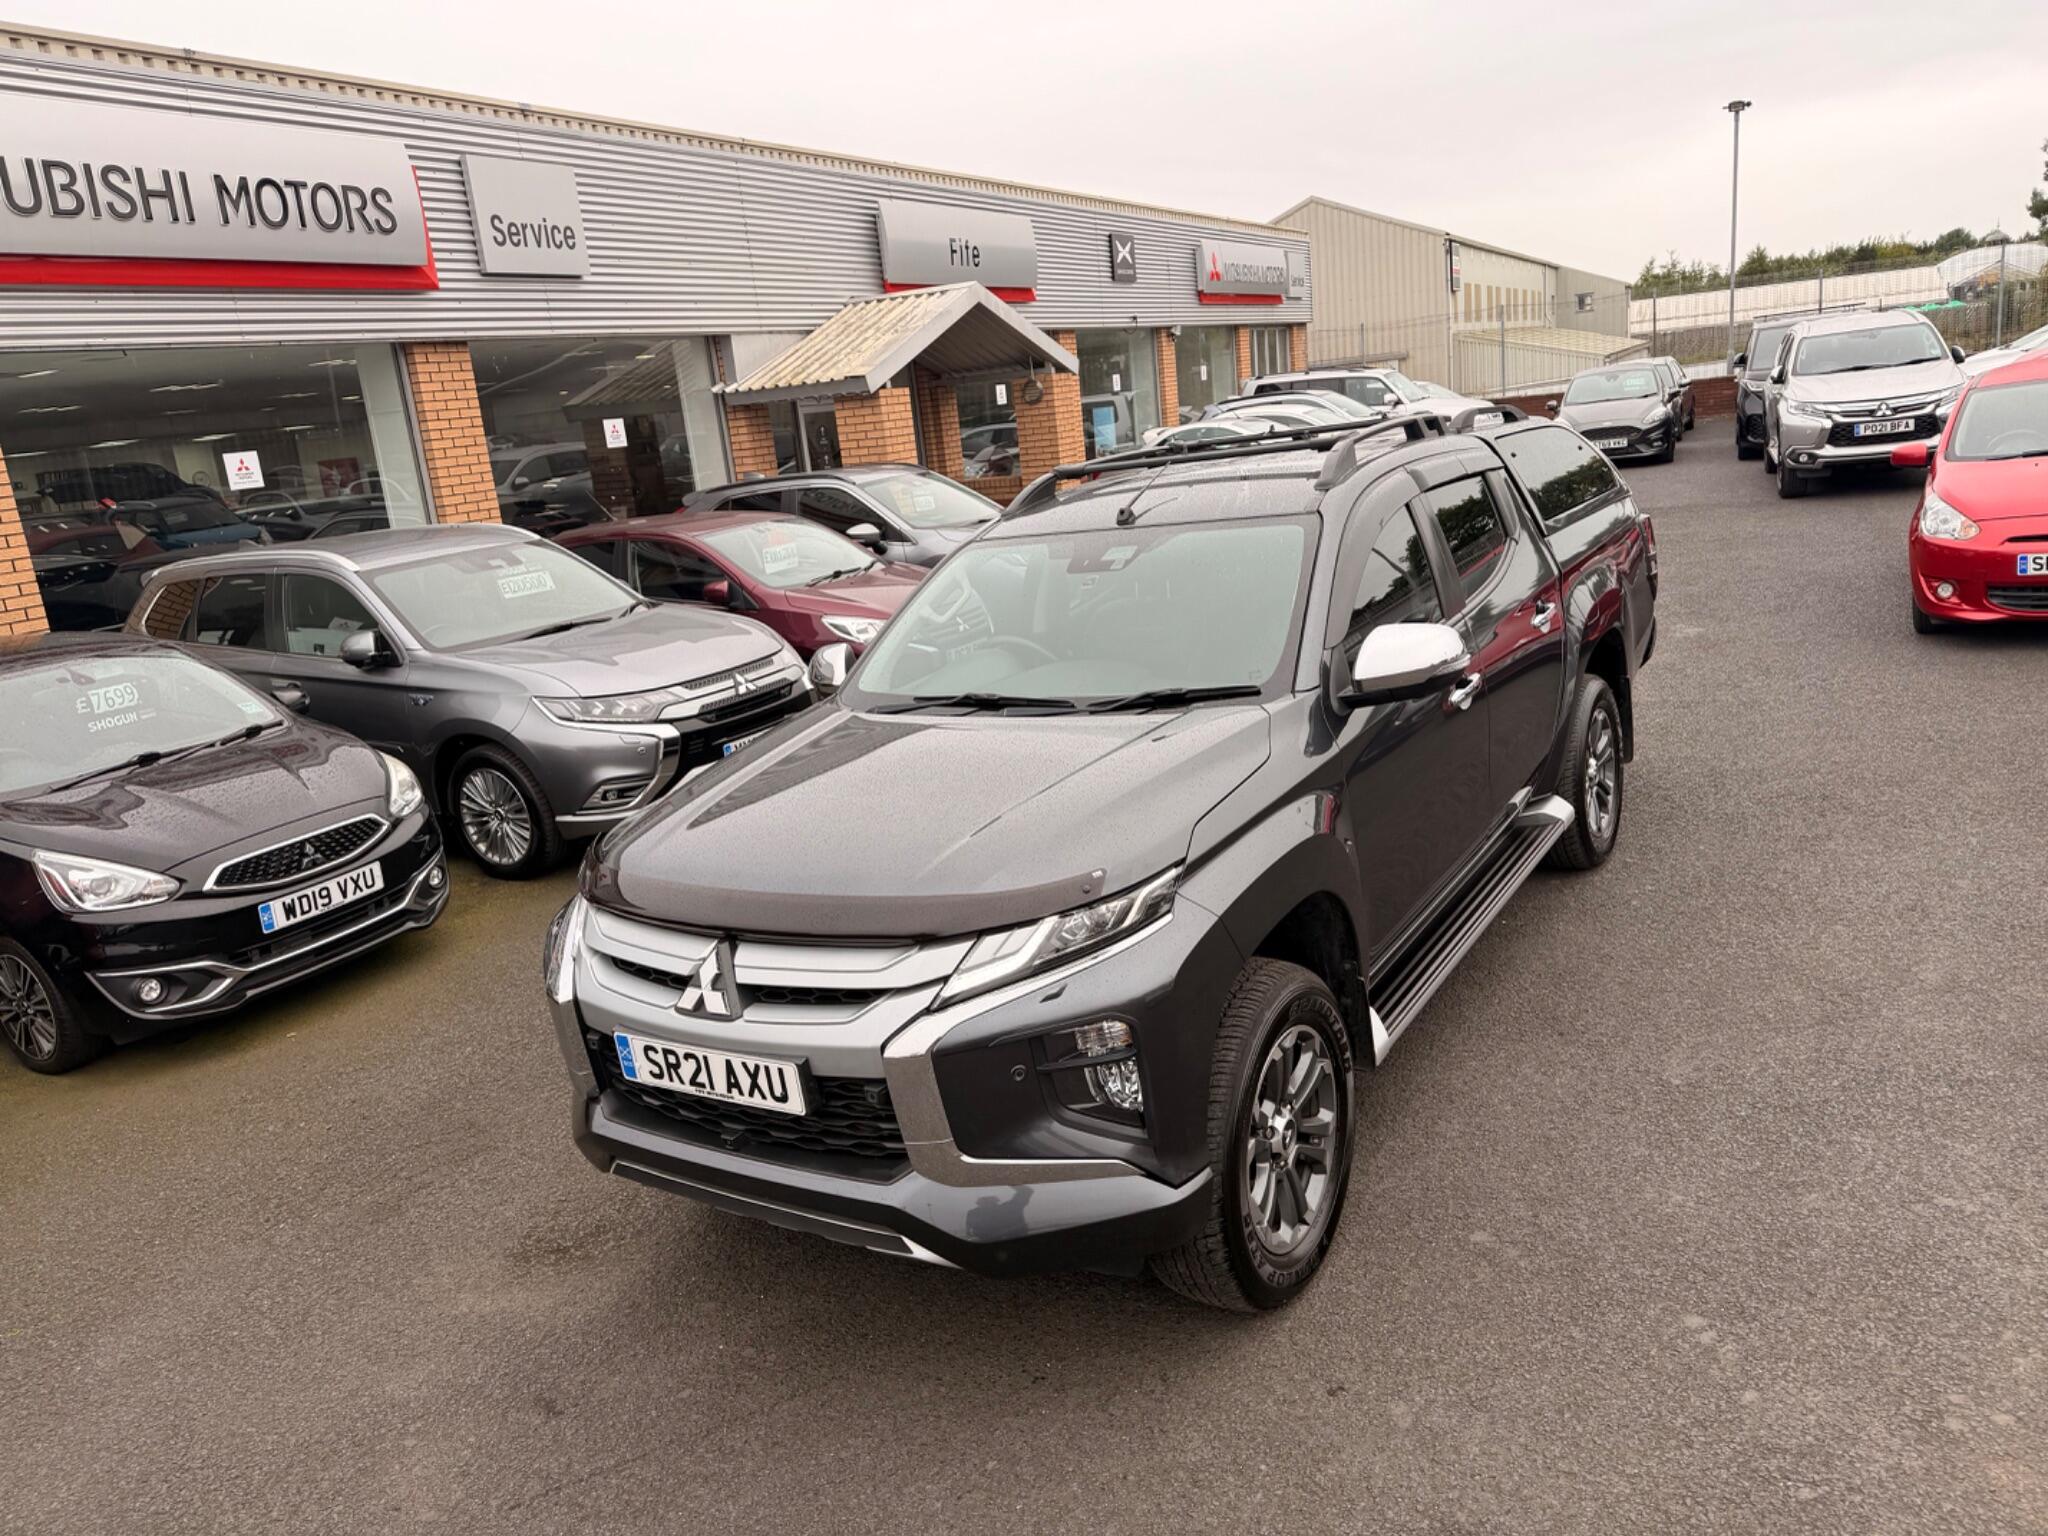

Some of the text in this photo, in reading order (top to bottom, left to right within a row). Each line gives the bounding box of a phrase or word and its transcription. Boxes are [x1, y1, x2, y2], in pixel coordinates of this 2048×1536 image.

[212, 173, 397, 234] MOTORS
[490, 214, 576, 250] Service
[949, 237, 981, 267] Fife
[1890, 420, 1910, 431] BFA
[2032, 555, 2048, 571] S
[87, 711, 138, 733] SHOGUN
[282, 868, 376, 922] WD19 VXU
[643, 1044, 788, 1103] SR21 AXU
